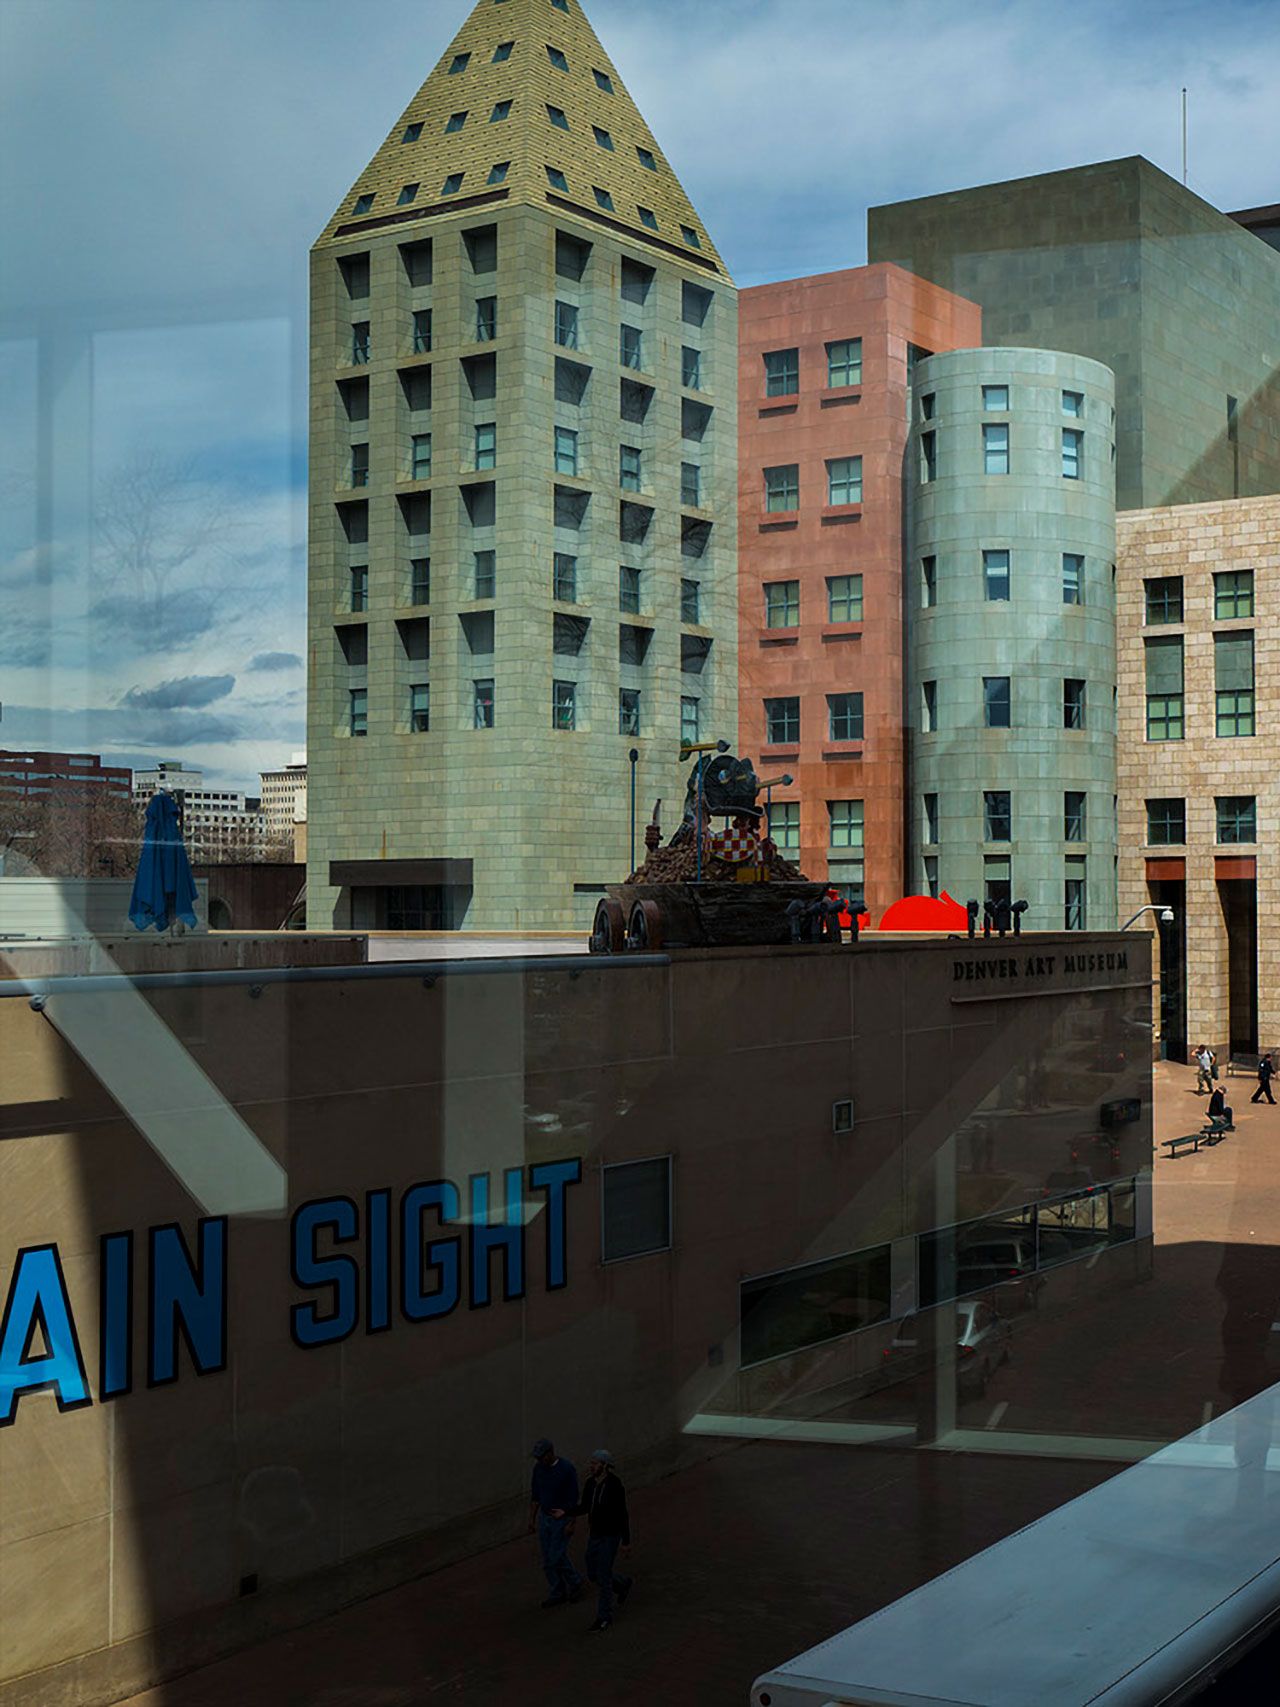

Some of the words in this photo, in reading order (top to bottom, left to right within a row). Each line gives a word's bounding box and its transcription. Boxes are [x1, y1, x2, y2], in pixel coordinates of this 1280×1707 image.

[953, 959, 1017, 981] DENVER
[1025, 956, 1055, 977] ART
[1064, 953, 1128, 973] MUSEUM
[0, 1214, 228, 1427] AIN
[289, 1156, 582, 1349] SIGHT
